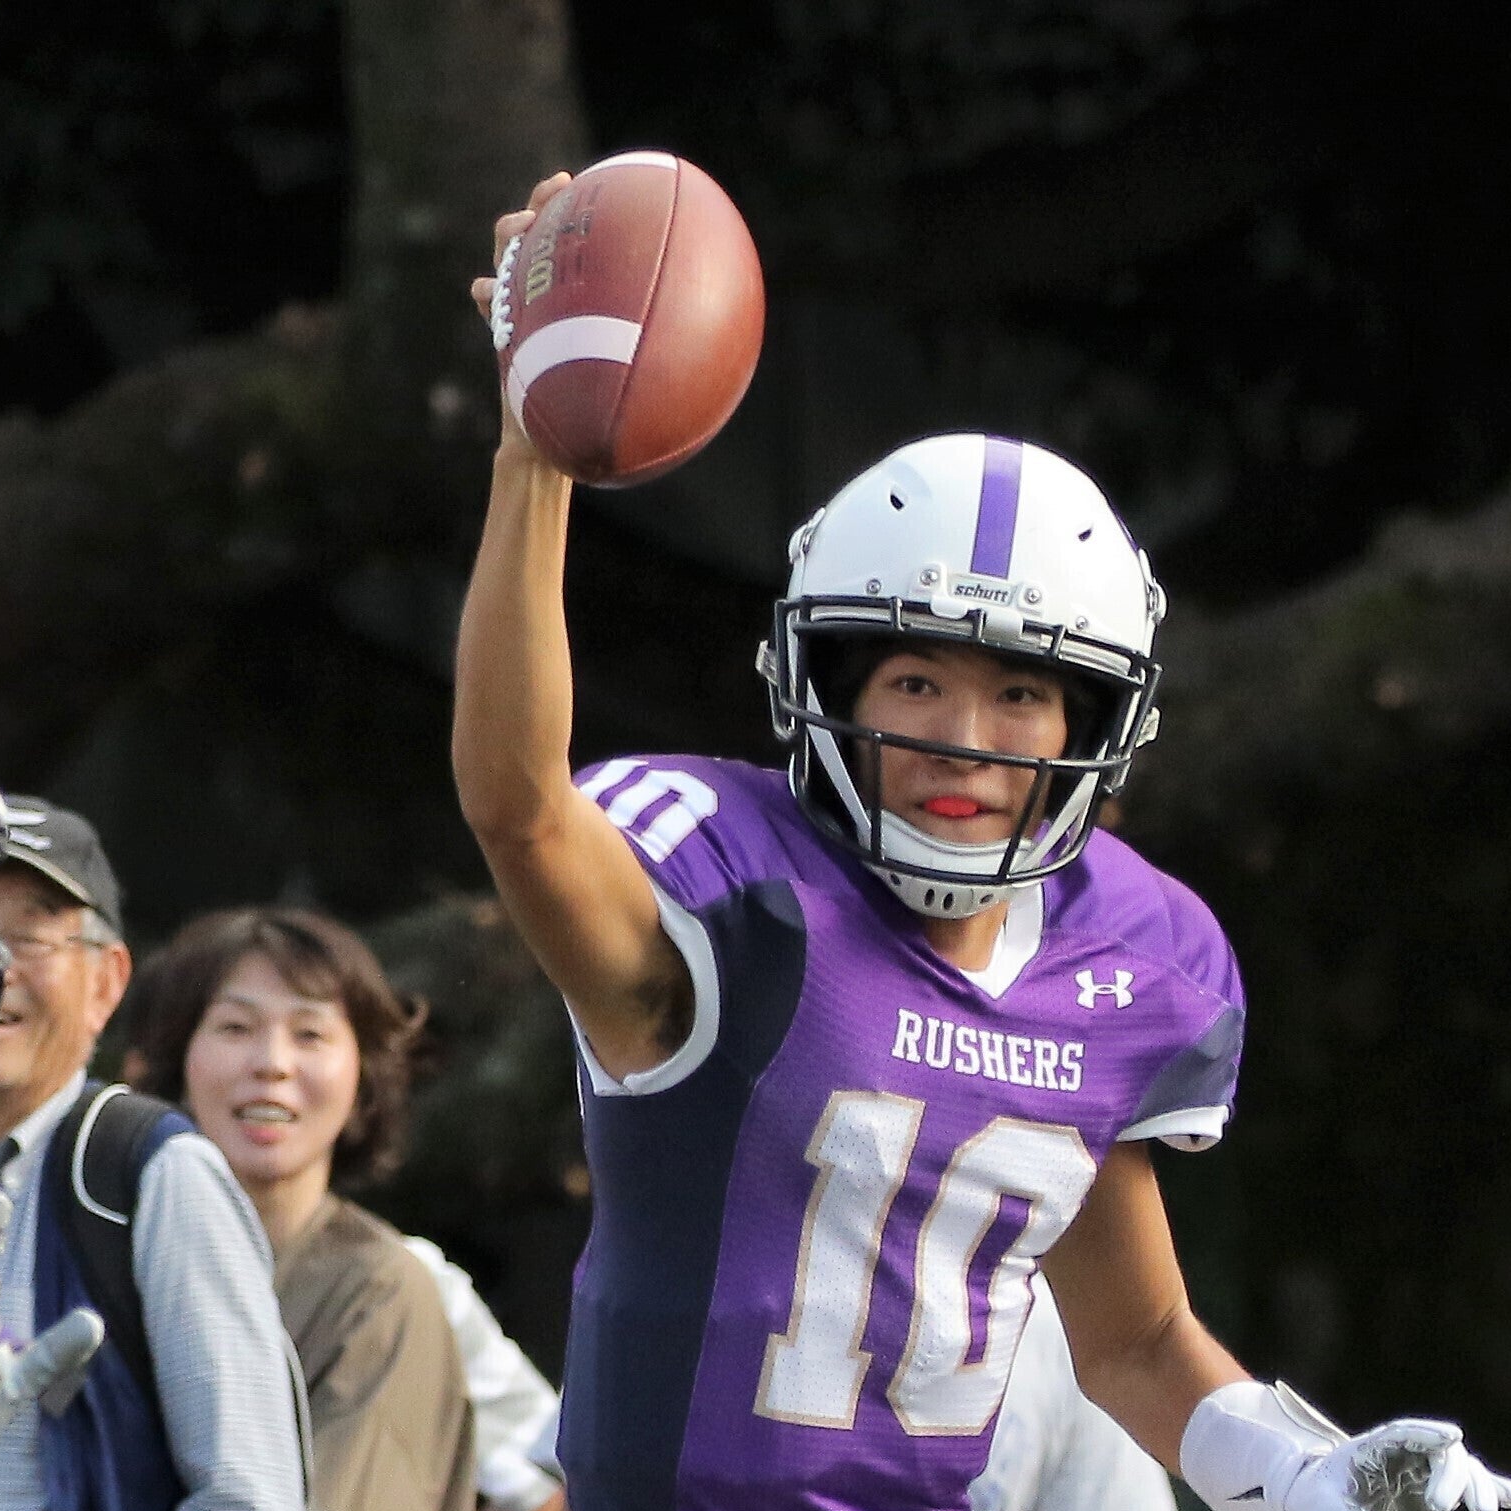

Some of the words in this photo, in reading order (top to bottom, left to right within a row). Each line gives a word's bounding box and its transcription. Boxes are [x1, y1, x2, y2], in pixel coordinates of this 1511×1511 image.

[954, 583, 1009, 602] schutt
[891, 1008, 1086, 1093] RUSHERS
[753, 1089, 1097, 1437] 10
